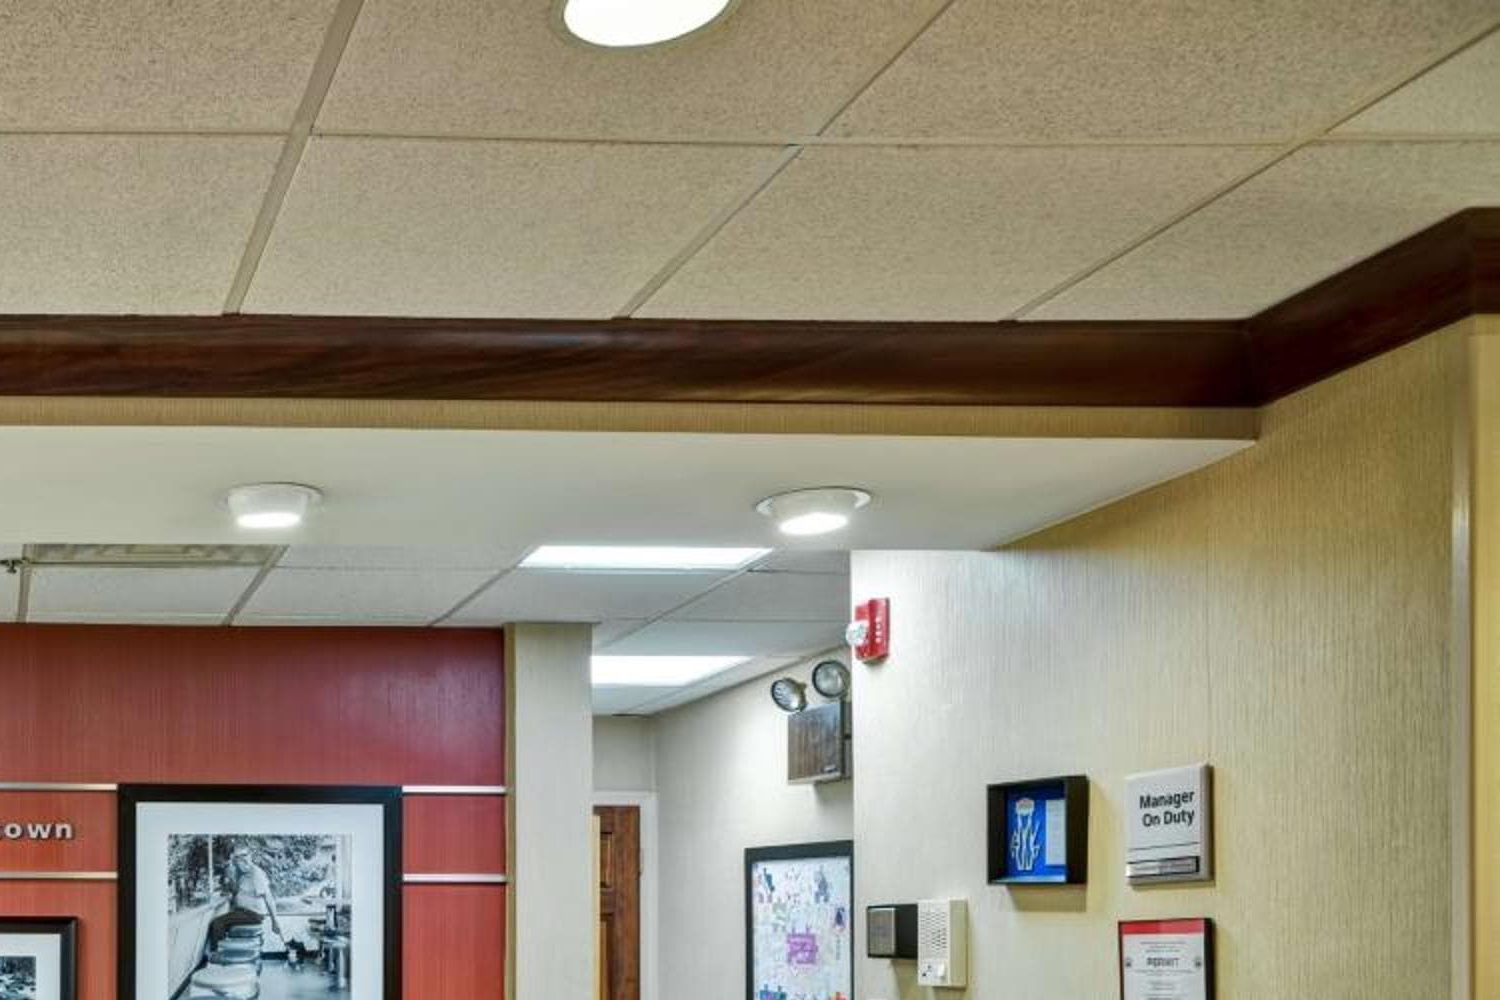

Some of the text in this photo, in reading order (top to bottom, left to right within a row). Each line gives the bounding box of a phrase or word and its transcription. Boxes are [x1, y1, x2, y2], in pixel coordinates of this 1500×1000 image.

[1140, 791, 1195, 809] Manager
[1142, 809, 1195, 827] On Duty
